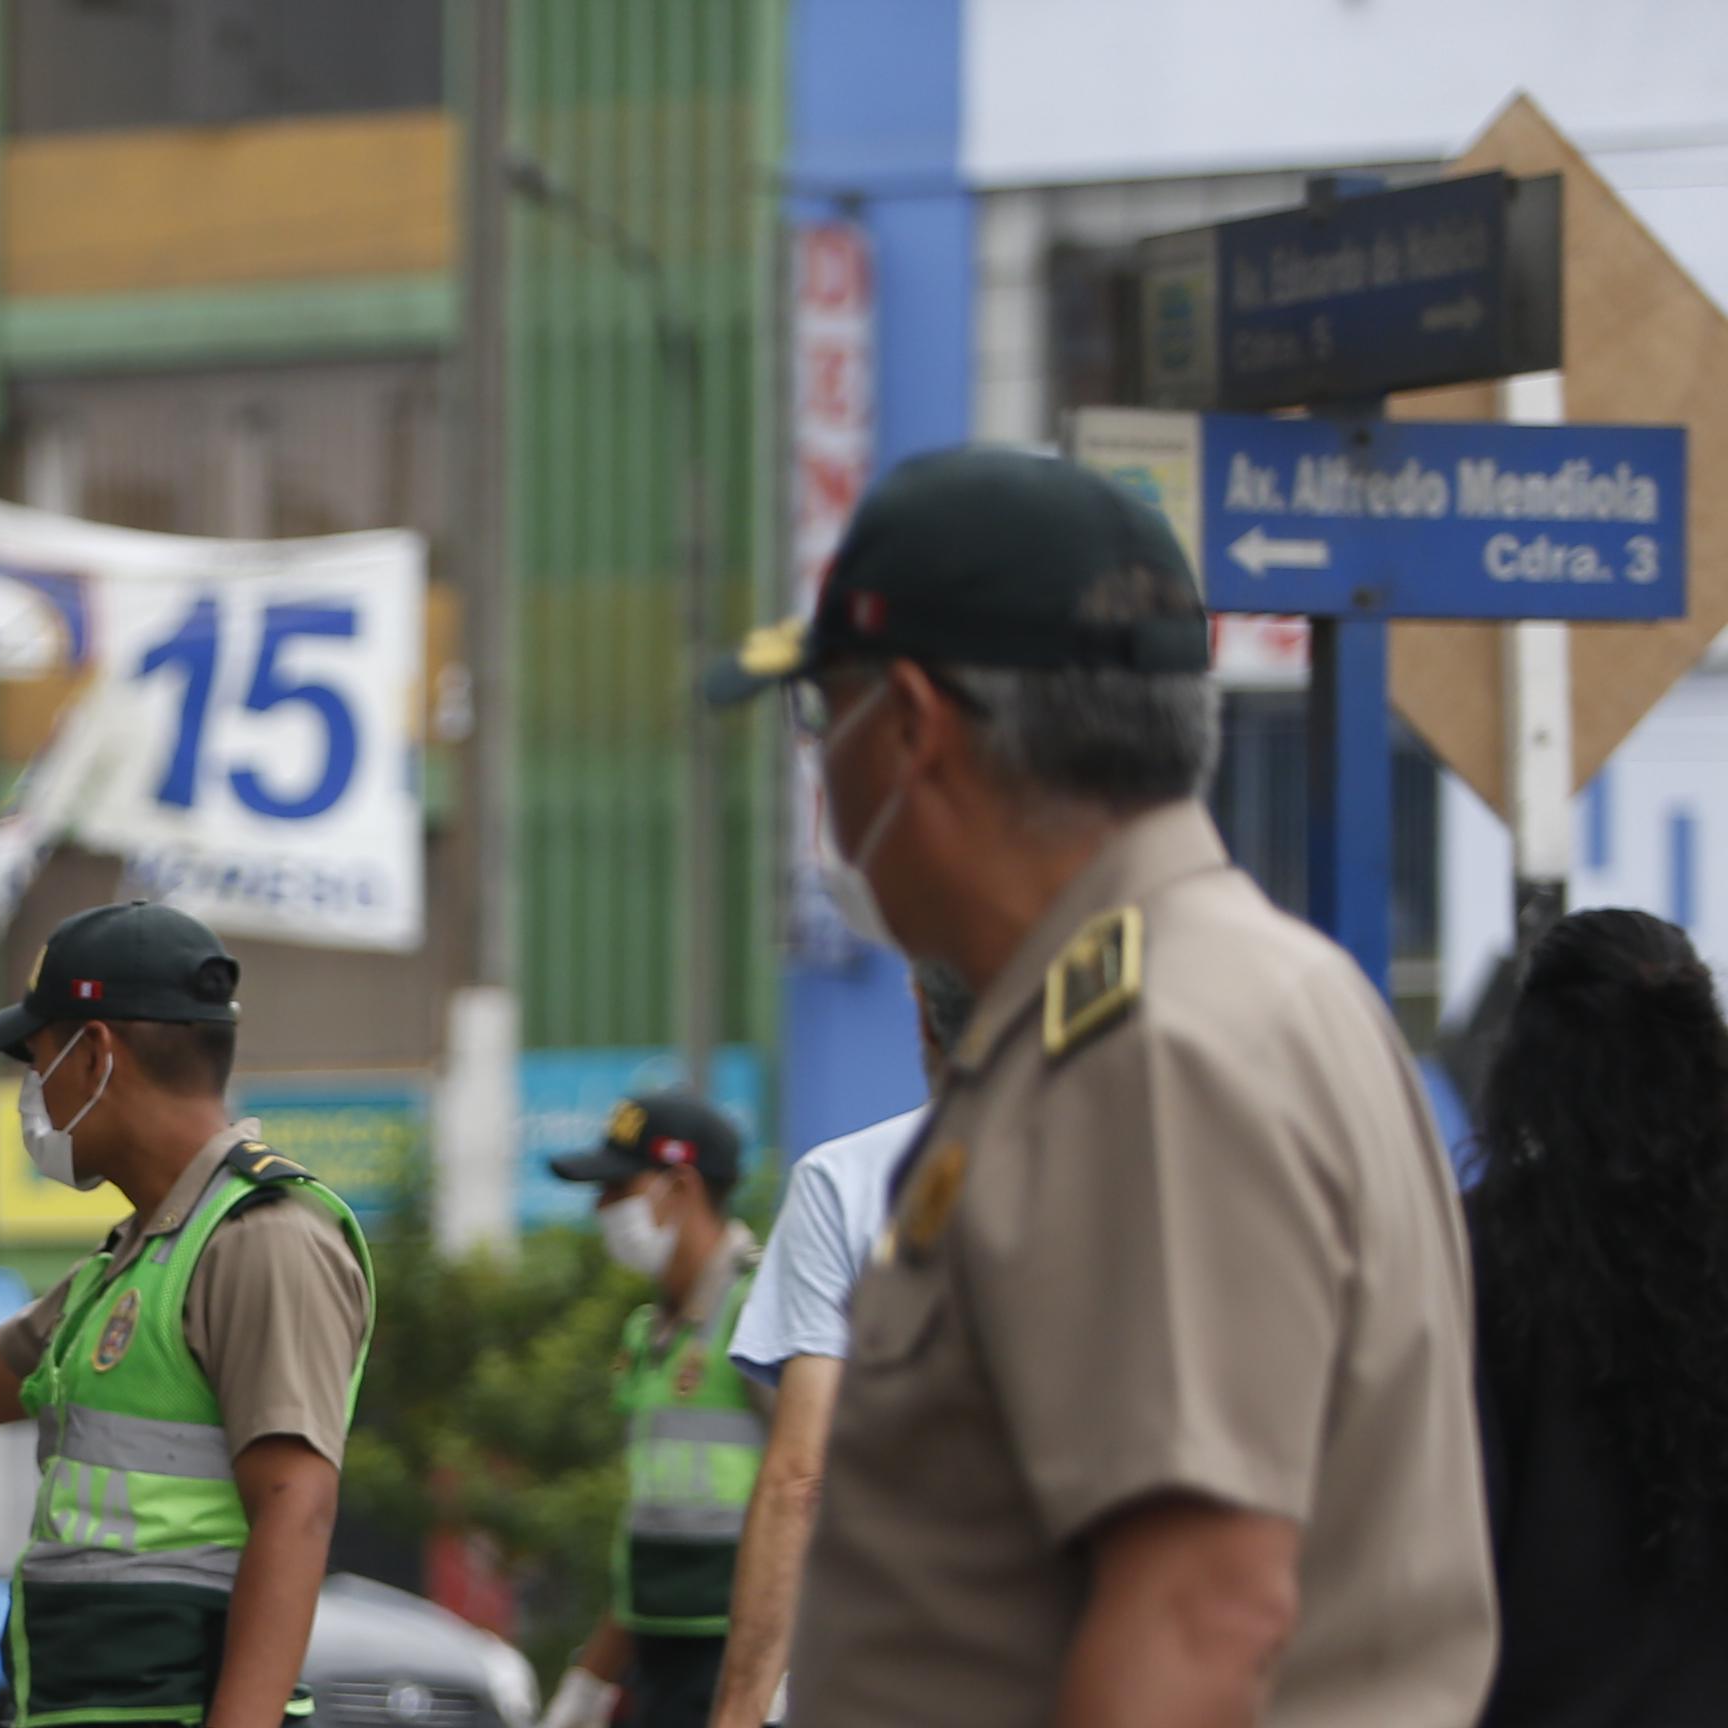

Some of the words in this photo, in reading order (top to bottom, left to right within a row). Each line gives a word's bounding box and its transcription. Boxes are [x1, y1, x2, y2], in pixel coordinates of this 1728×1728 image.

[1226, 450, 1285, 513] Av.
[1291, 453, 1447, 518] Alfredo
[1456, 457, 1660, 523] Mendiola
[1484, 532, 1614, 584] Cdra.
[1623, 533, 1660, 585] 3
[136, 594, 359, 819] 15
